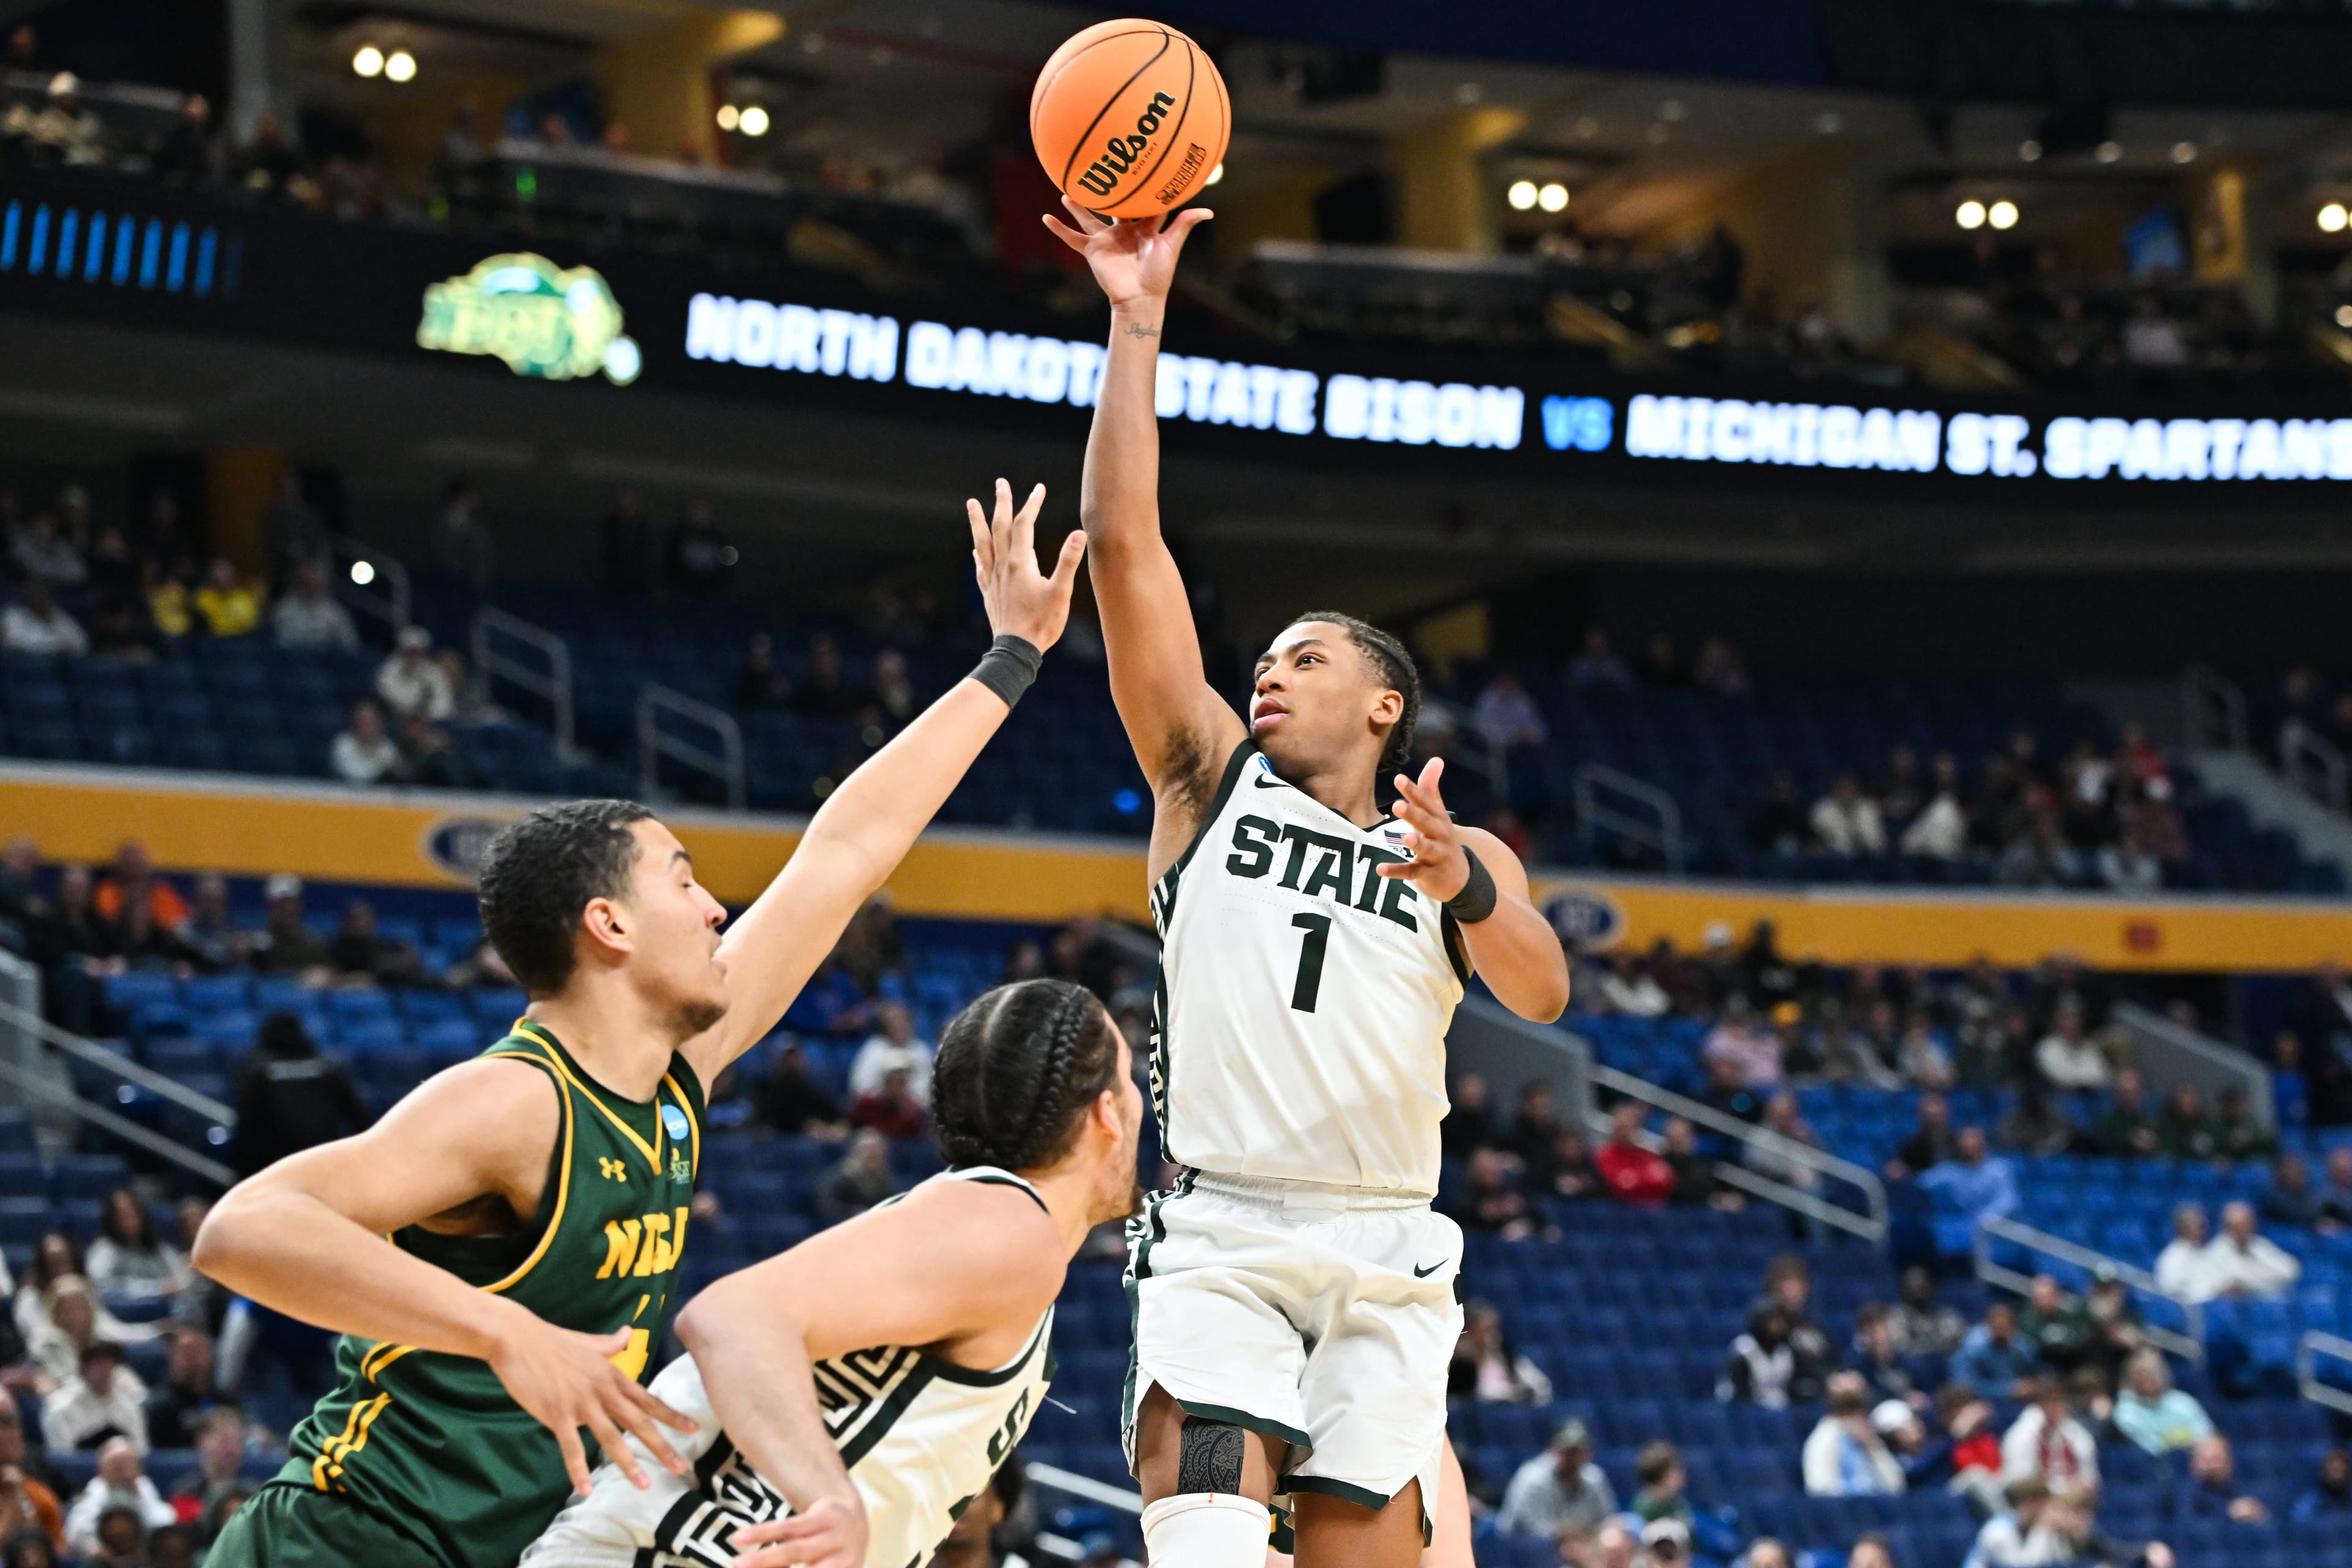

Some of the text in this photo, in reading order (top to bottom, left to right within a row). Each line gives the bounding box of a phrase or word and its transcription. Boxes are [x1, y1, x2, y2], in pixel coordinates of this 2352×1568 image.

[1078, 90, 1175, 197] Wilson
[685, 292, 900, 383] NORTH
[1155, 352, 1319, 435] STATE
[1324, 374, 1525, 450] BISON
[1542, 395, 1615, 452] VS
[1626, 394, 1942, 473] MICHIGAN
[1945, 412, 2038, 478] ST.
[2043, 417, 2352, 481] SPARTANS
[1226, 813, 1419, 934] STATE
[1291, 913, 1332, 1013] 1
